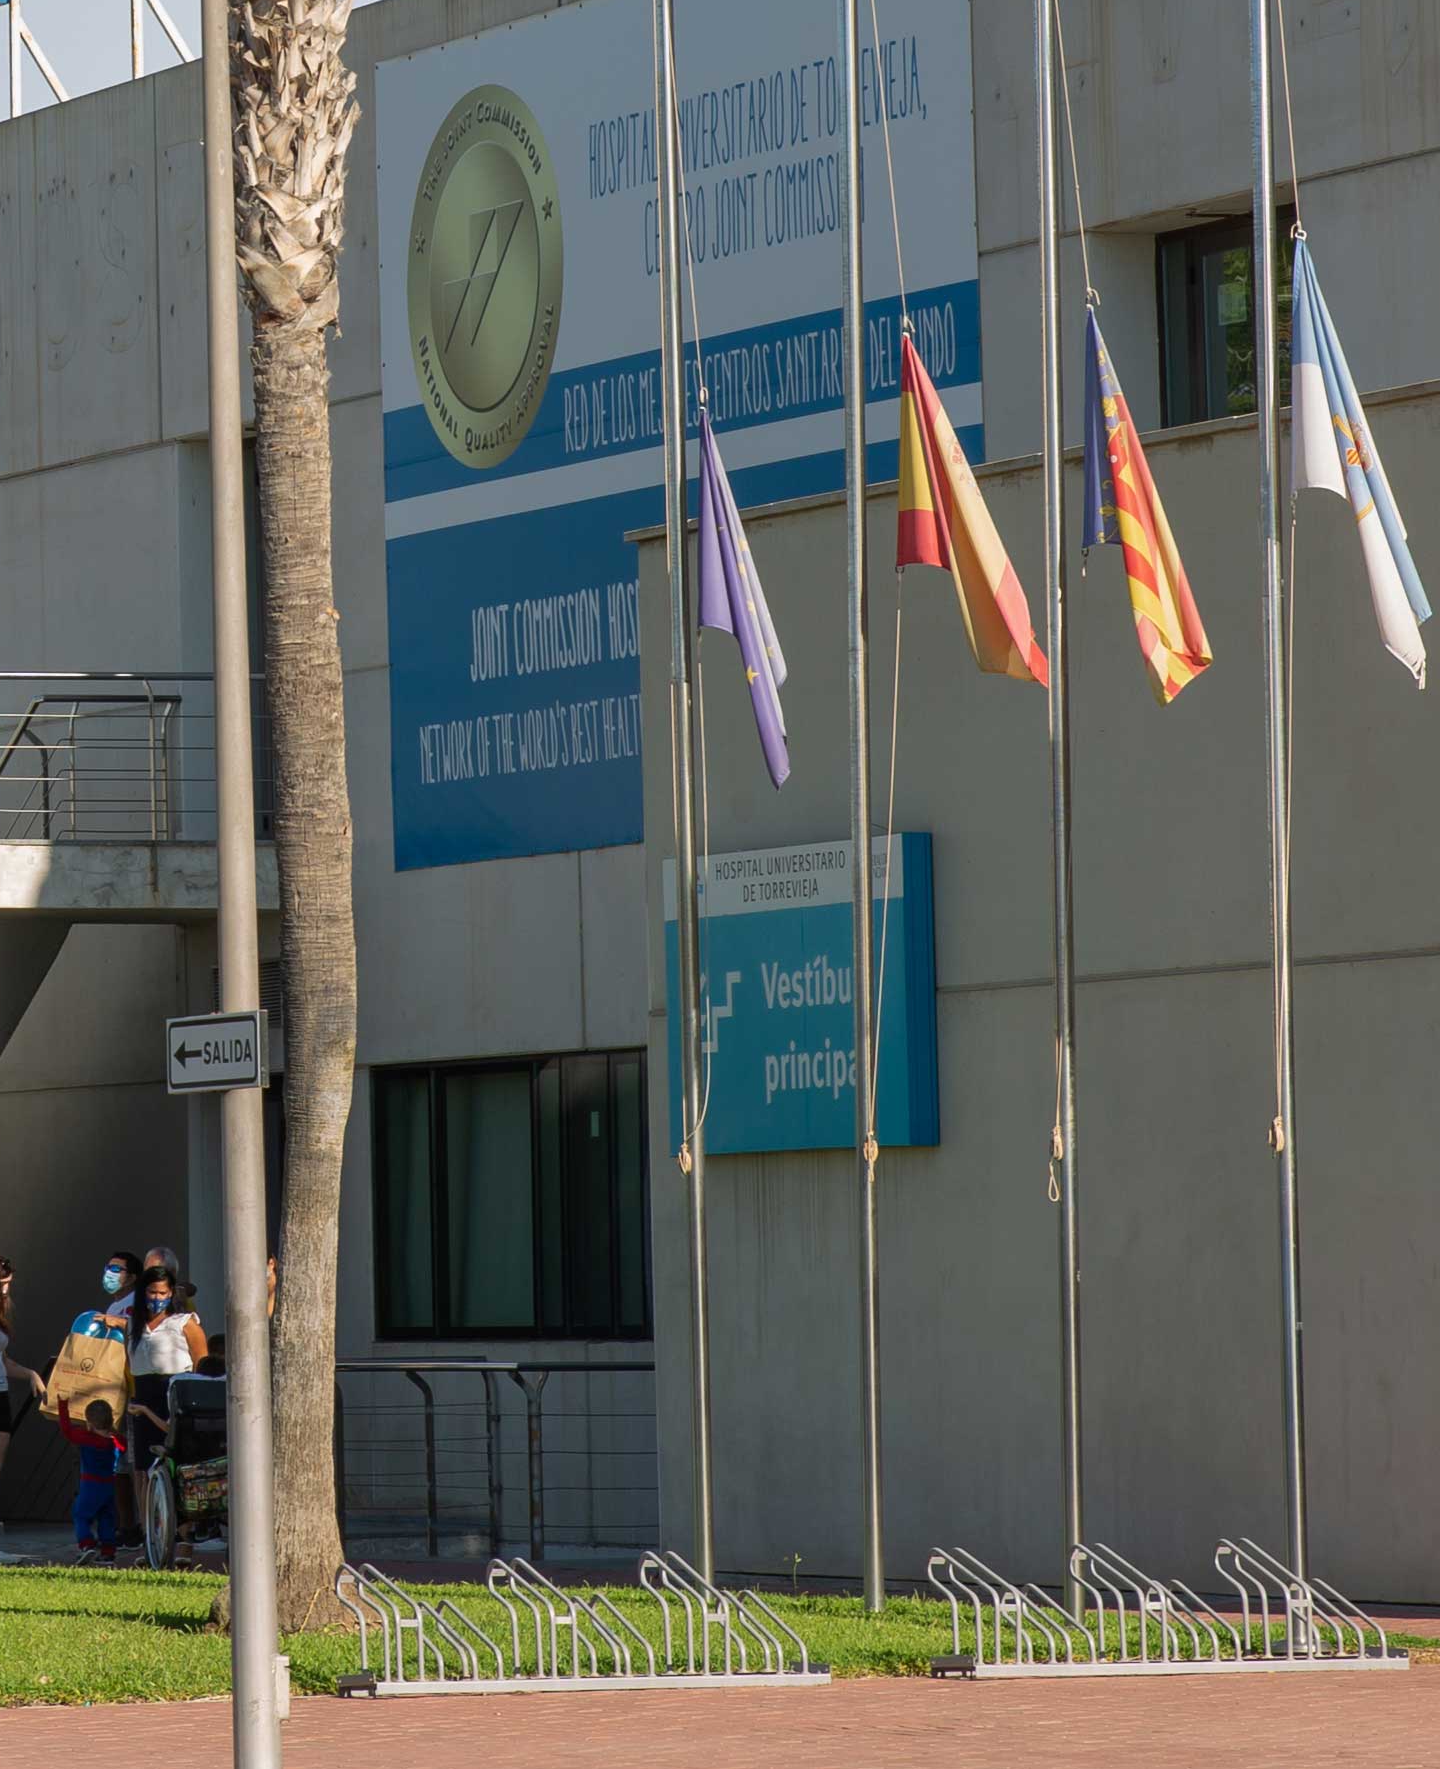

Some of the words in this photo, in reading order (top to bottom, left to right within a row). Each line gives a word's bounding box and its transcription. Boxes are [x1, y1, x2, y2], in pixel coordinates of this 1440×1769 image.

[423, 158, 443, 202] THE
[442, 110, 474, 159] JOINT
[589, 109, 658, 199] HOSPITAL
[676, 70, 785, 174] NIVERSITARIO
[791, 65, 808, 147] DE
[813, 34, 927, 138] TOEVIEJA,
[644, 184, 705, 276] CERO
[712, 172, 757, 262] JOINT
[763, 145, 865, 248] COMMISSI
[418, 334, 458, 439] NATIONAL
[515, 303, 554, 424] APPROVAL
[563, 381, 587, 454] RED
[591, 375, 608, 448] DE
[610, 369, 636, 443] LOS
[638, 358, 701, 439] MEES
[704, 342, 771, 425] CENTROS
[868, 316, 897, 391] DEL
[470, 604, 509, 683] JOINT
[513, 588, 602, 676] COMMISSION
[420, 721, 474, 785] NETWORK
[476, 716, 490, 778] OF
[492, 713, 516, 775] THE
[517, 700, 569, 772] WORLD'S
[570, 701, 599, 766] BEST
[715, 856, 764, 881] HOSPITAL
[766, 850, 847, 876] UNIVERSITARIO
[742, 884, 757, 903] DE
[759, 878, 820, 902] TORREVIEJA
[761, 954, 852, 1010] Vestíbu
[203, 1038, 253, 1065] SALIDA
[764, 1037, 858, 1105] principa
